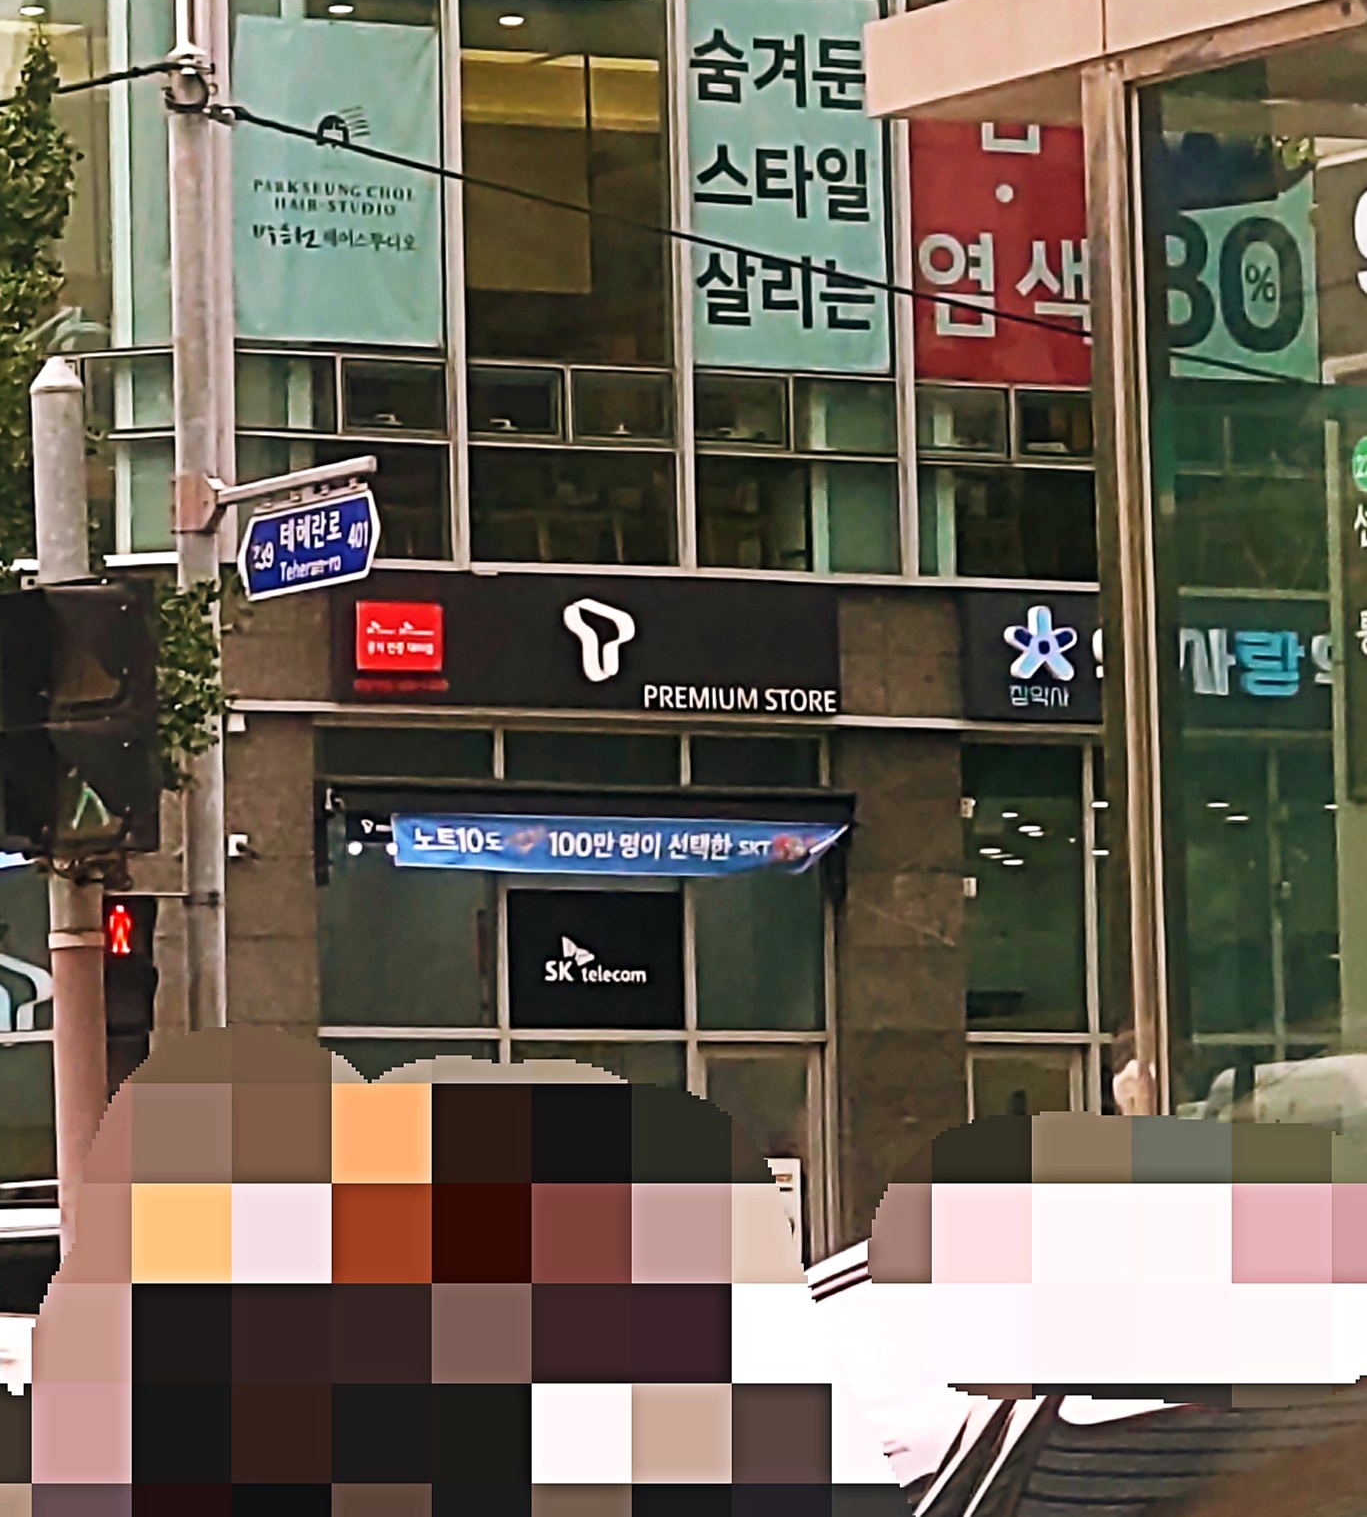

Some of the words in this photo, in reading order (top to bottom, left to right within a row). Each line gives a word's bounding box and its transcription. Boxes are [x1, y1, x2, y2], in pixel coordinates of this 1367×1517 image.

[689, 28, 867, 110] 숨겨둔
[694, 144, 871, 223] 스타일
[696, 251, 876, 330] 살리는
[643, 685, 759, 710] PREMIUM
[764, 688, 837, 712] STORE
[413, 827, 505, 854] 노트10도
[549, 831, 615, 858] 100만
[667, 833, 733, 860] 선택한
[737, 839, 773, 857] SKT
[544, 960, 575, 983] SK
[581, 965, 648, 984] telecom
